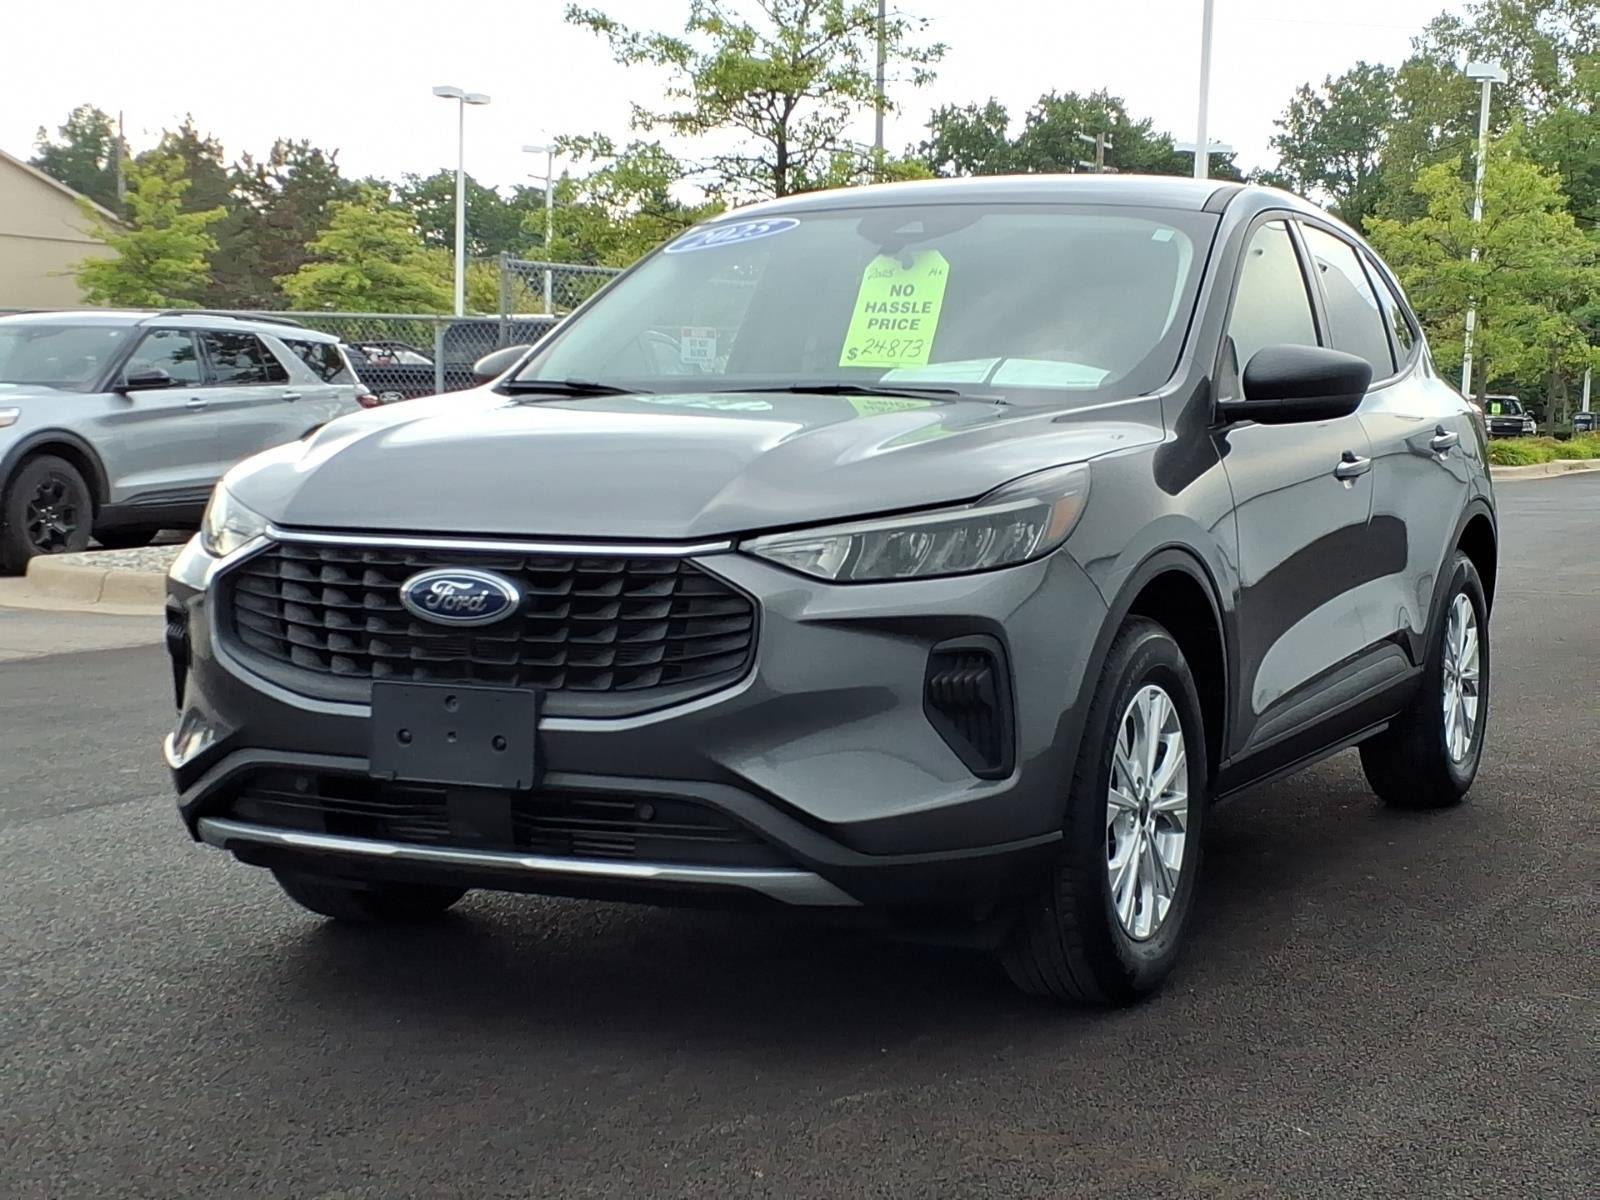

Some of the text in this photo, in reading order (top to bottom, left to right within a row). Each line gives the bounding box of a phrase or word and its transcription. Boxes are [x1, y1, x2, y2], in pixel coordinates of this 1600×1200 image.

[889, 284, 915, 297] NO
[864, 301, 932, 314] HASSLE
[867, 318, 921, 331] PRICE
[861, 338, 924, 358] 24873
[425, 580, 489, 611] Ford
